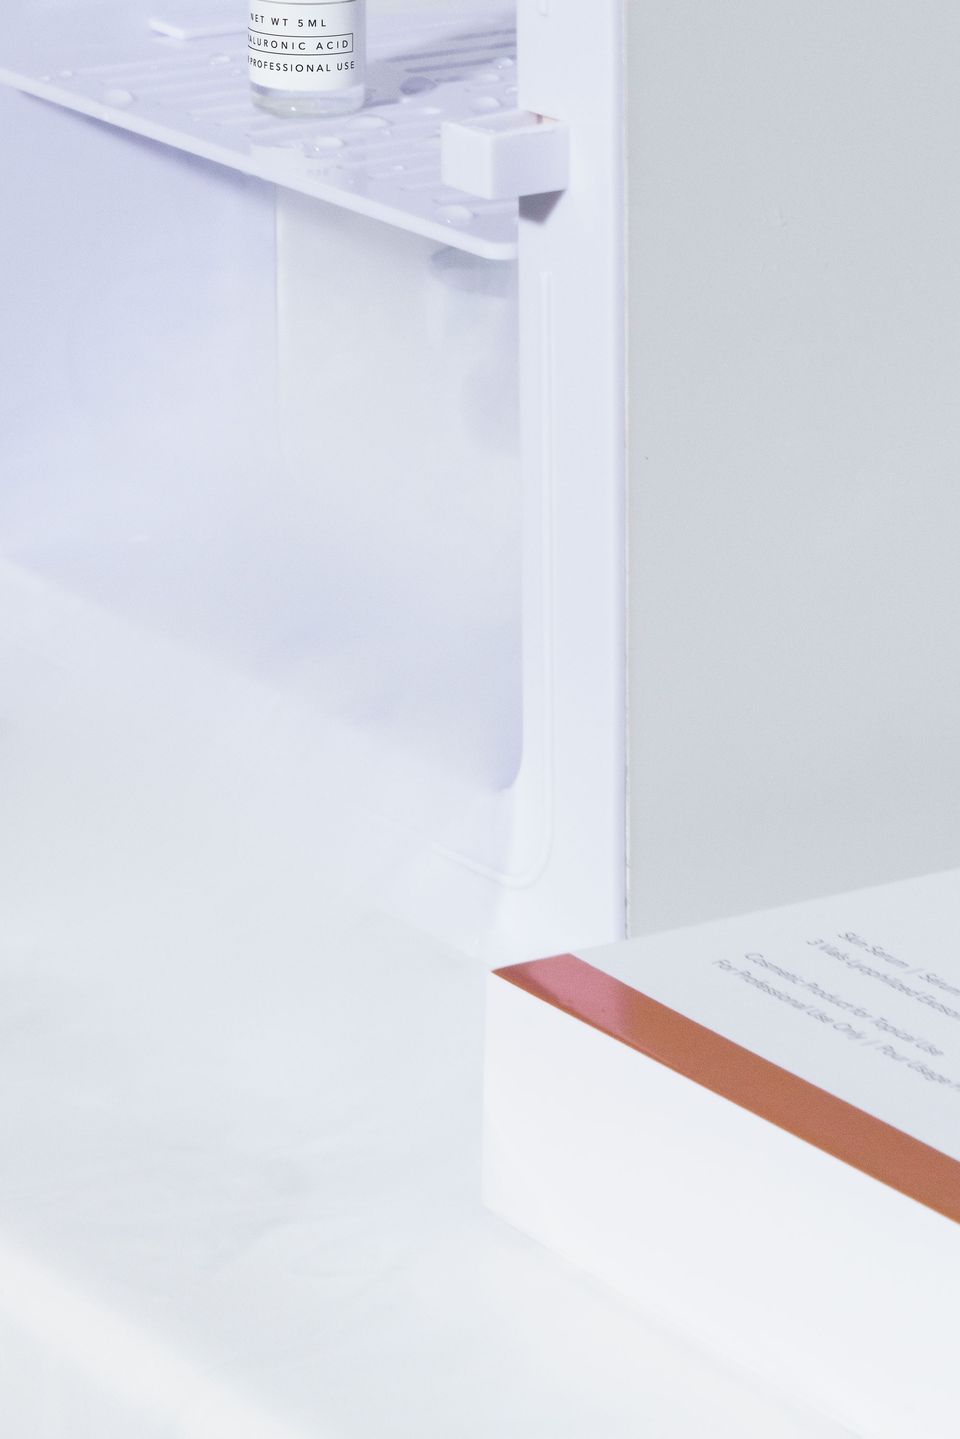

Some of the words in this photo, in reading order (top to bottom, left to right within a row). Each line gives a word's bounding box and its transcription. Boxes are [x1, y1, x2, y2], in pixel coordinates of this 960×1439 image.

[250, 13, 265, 24] NET
[271, 17, 289, 27] WT
[248, 33, 306, 51] ALURONIC
[315, 40, 349, 50] ACID
[249, 57, 331, 73] PROFESSIONAL
[336, 61, 355, 72] USE
[711, 959, 740, 972] For
[732, 970, 813, 1011] Professional
[805, 1007, 835, 1024] Use
[832, 1022, 868, 1040] Only
[744, 952, 806, 984] Cosmetic
[914, 1040, 944, 1057] Use
